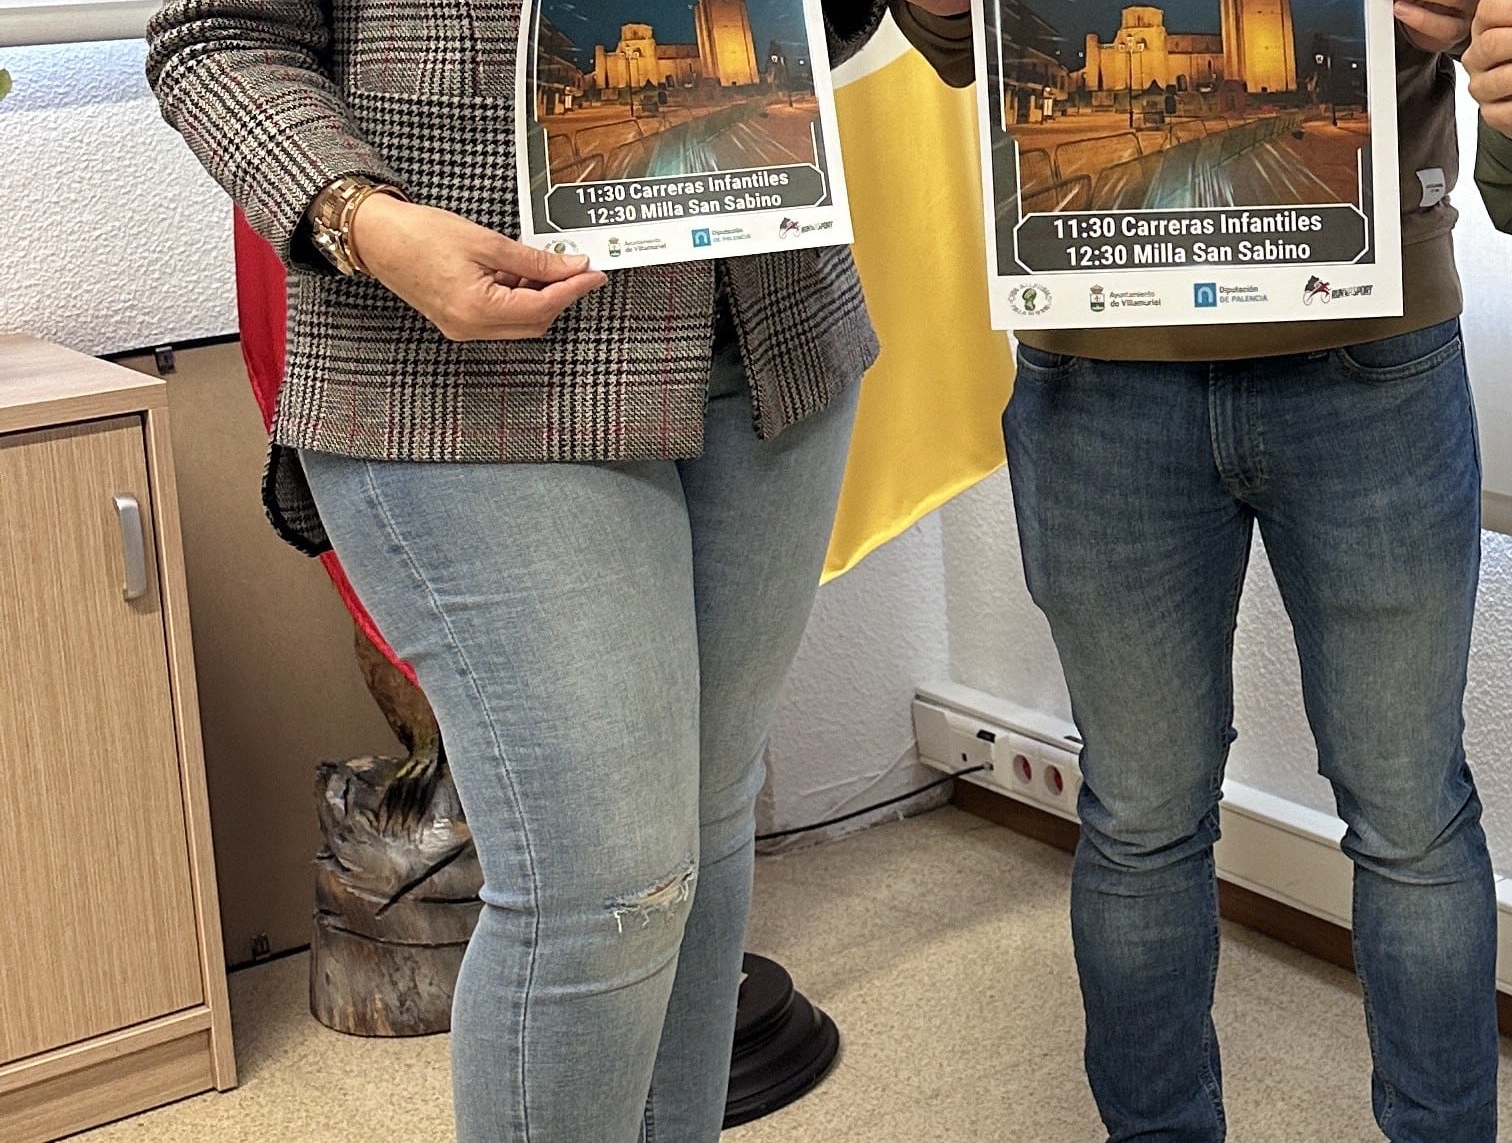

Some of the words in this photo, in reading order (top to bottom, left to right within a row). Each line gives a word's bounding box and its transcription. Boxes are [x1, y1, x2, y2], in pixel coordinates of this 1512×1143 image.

[575, 185, 626, 204] 11:30
[629, 177, 705, 198] Carreras
[708, 170, 789, 193] Infantiles
[587, 207, 637, 225] 12:30
[640, 201, 684, 221] Milla
[688, 197, 720, 216] San
[724, 192, 782, 212] Sabino
[1054, 217, 1116, 240] 11:30
[1121, 214, 1214, 237] Carreras
[1220, 210, 1322, 234] Infantiles
[1066, 244, 1128, 266] 12:30
[1133, 242, 1187, 264] Milla
[1193, 240, 1235, 262] San
[1239, 238, 1311, 261] Sabino
[1219, 295, 1231, 303] DE
[1231, 294, 1268, 303] PALENCIA
